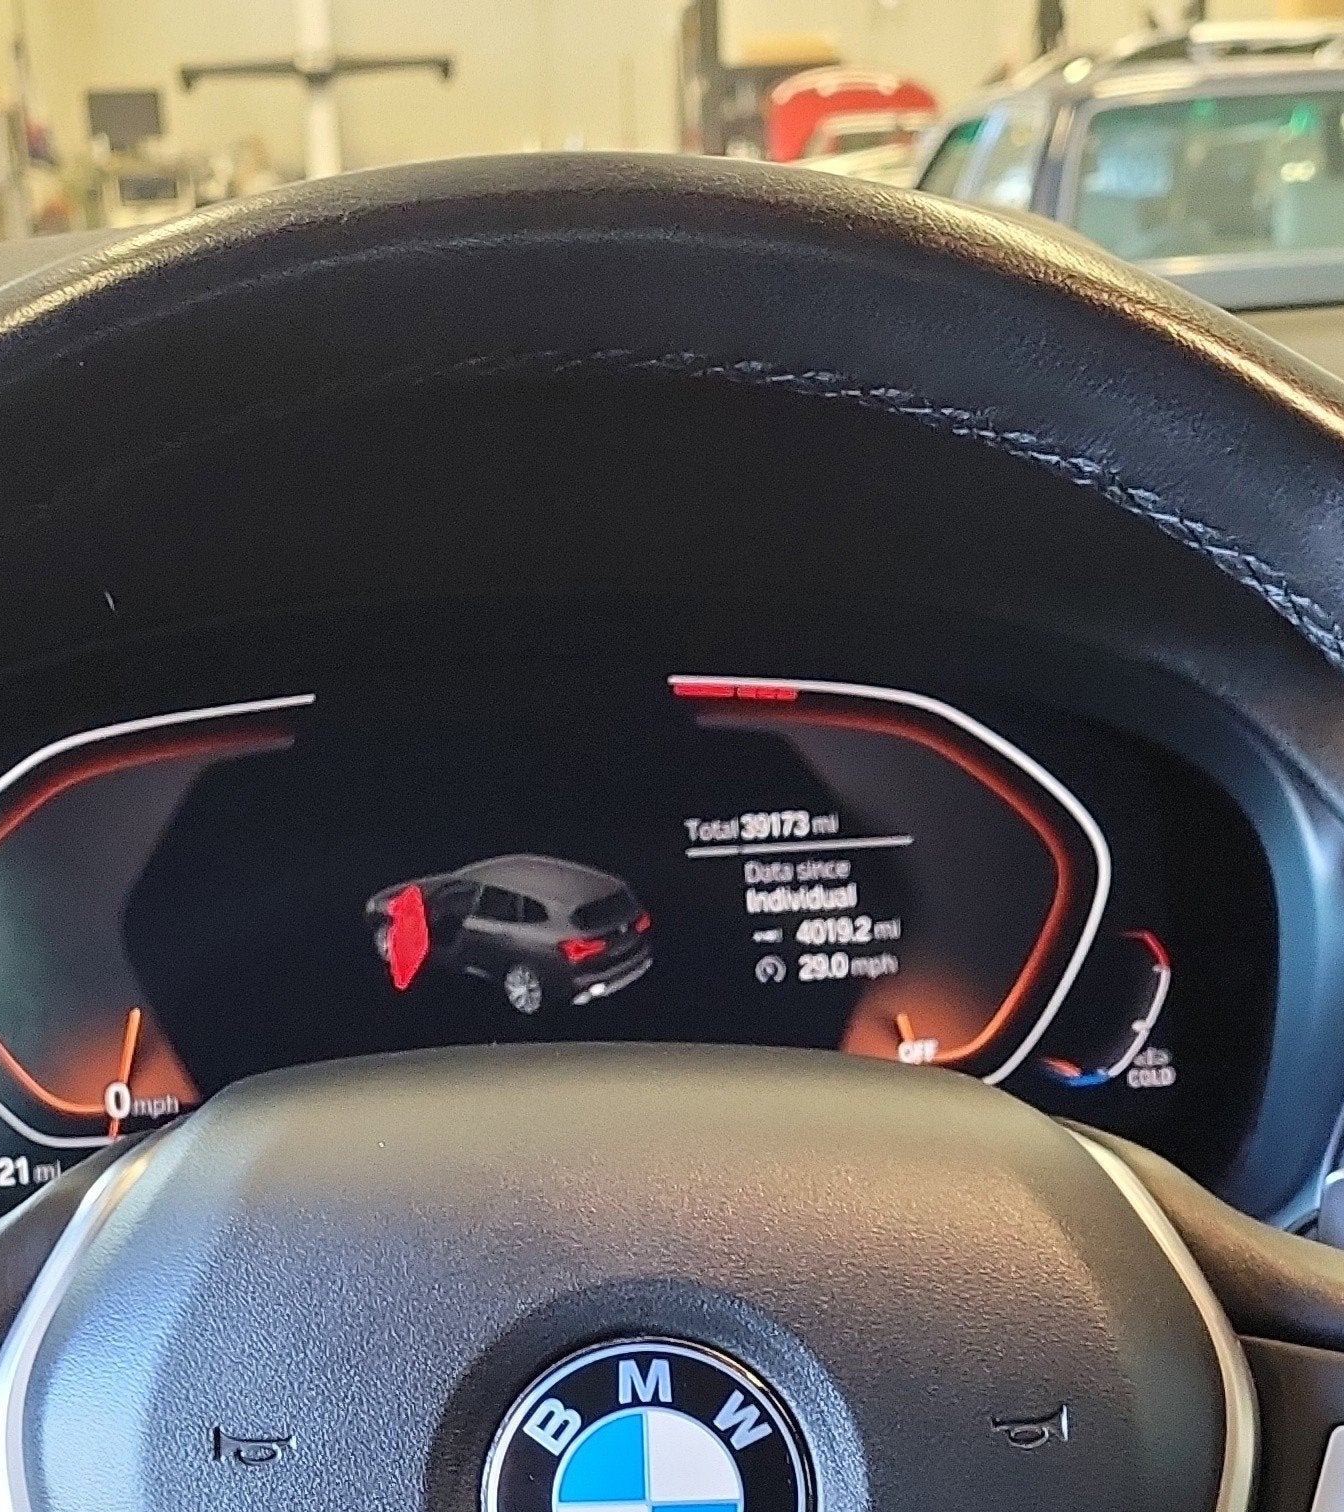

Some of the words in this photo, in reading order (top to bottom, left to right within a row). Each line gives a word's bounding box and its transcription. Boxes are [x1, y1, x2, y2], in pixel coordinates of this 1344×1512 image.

[684, 817, 739, 842] Total
[740, 811, 810, 839] 39173
[744, 860, 794, 884] Data
[795, 859, 851, 881] since
[746, 882, 857, 913] Individual
[795, 915, 873, 945] 4019.2
[798, 951, 849, 981] 29.0
[850, 953, 899, 980] mph
[105, 1082, 131, 1119] 0
[132, 1094, 179, 1119] mph
[522, 1358, 773, 1456] BMW
